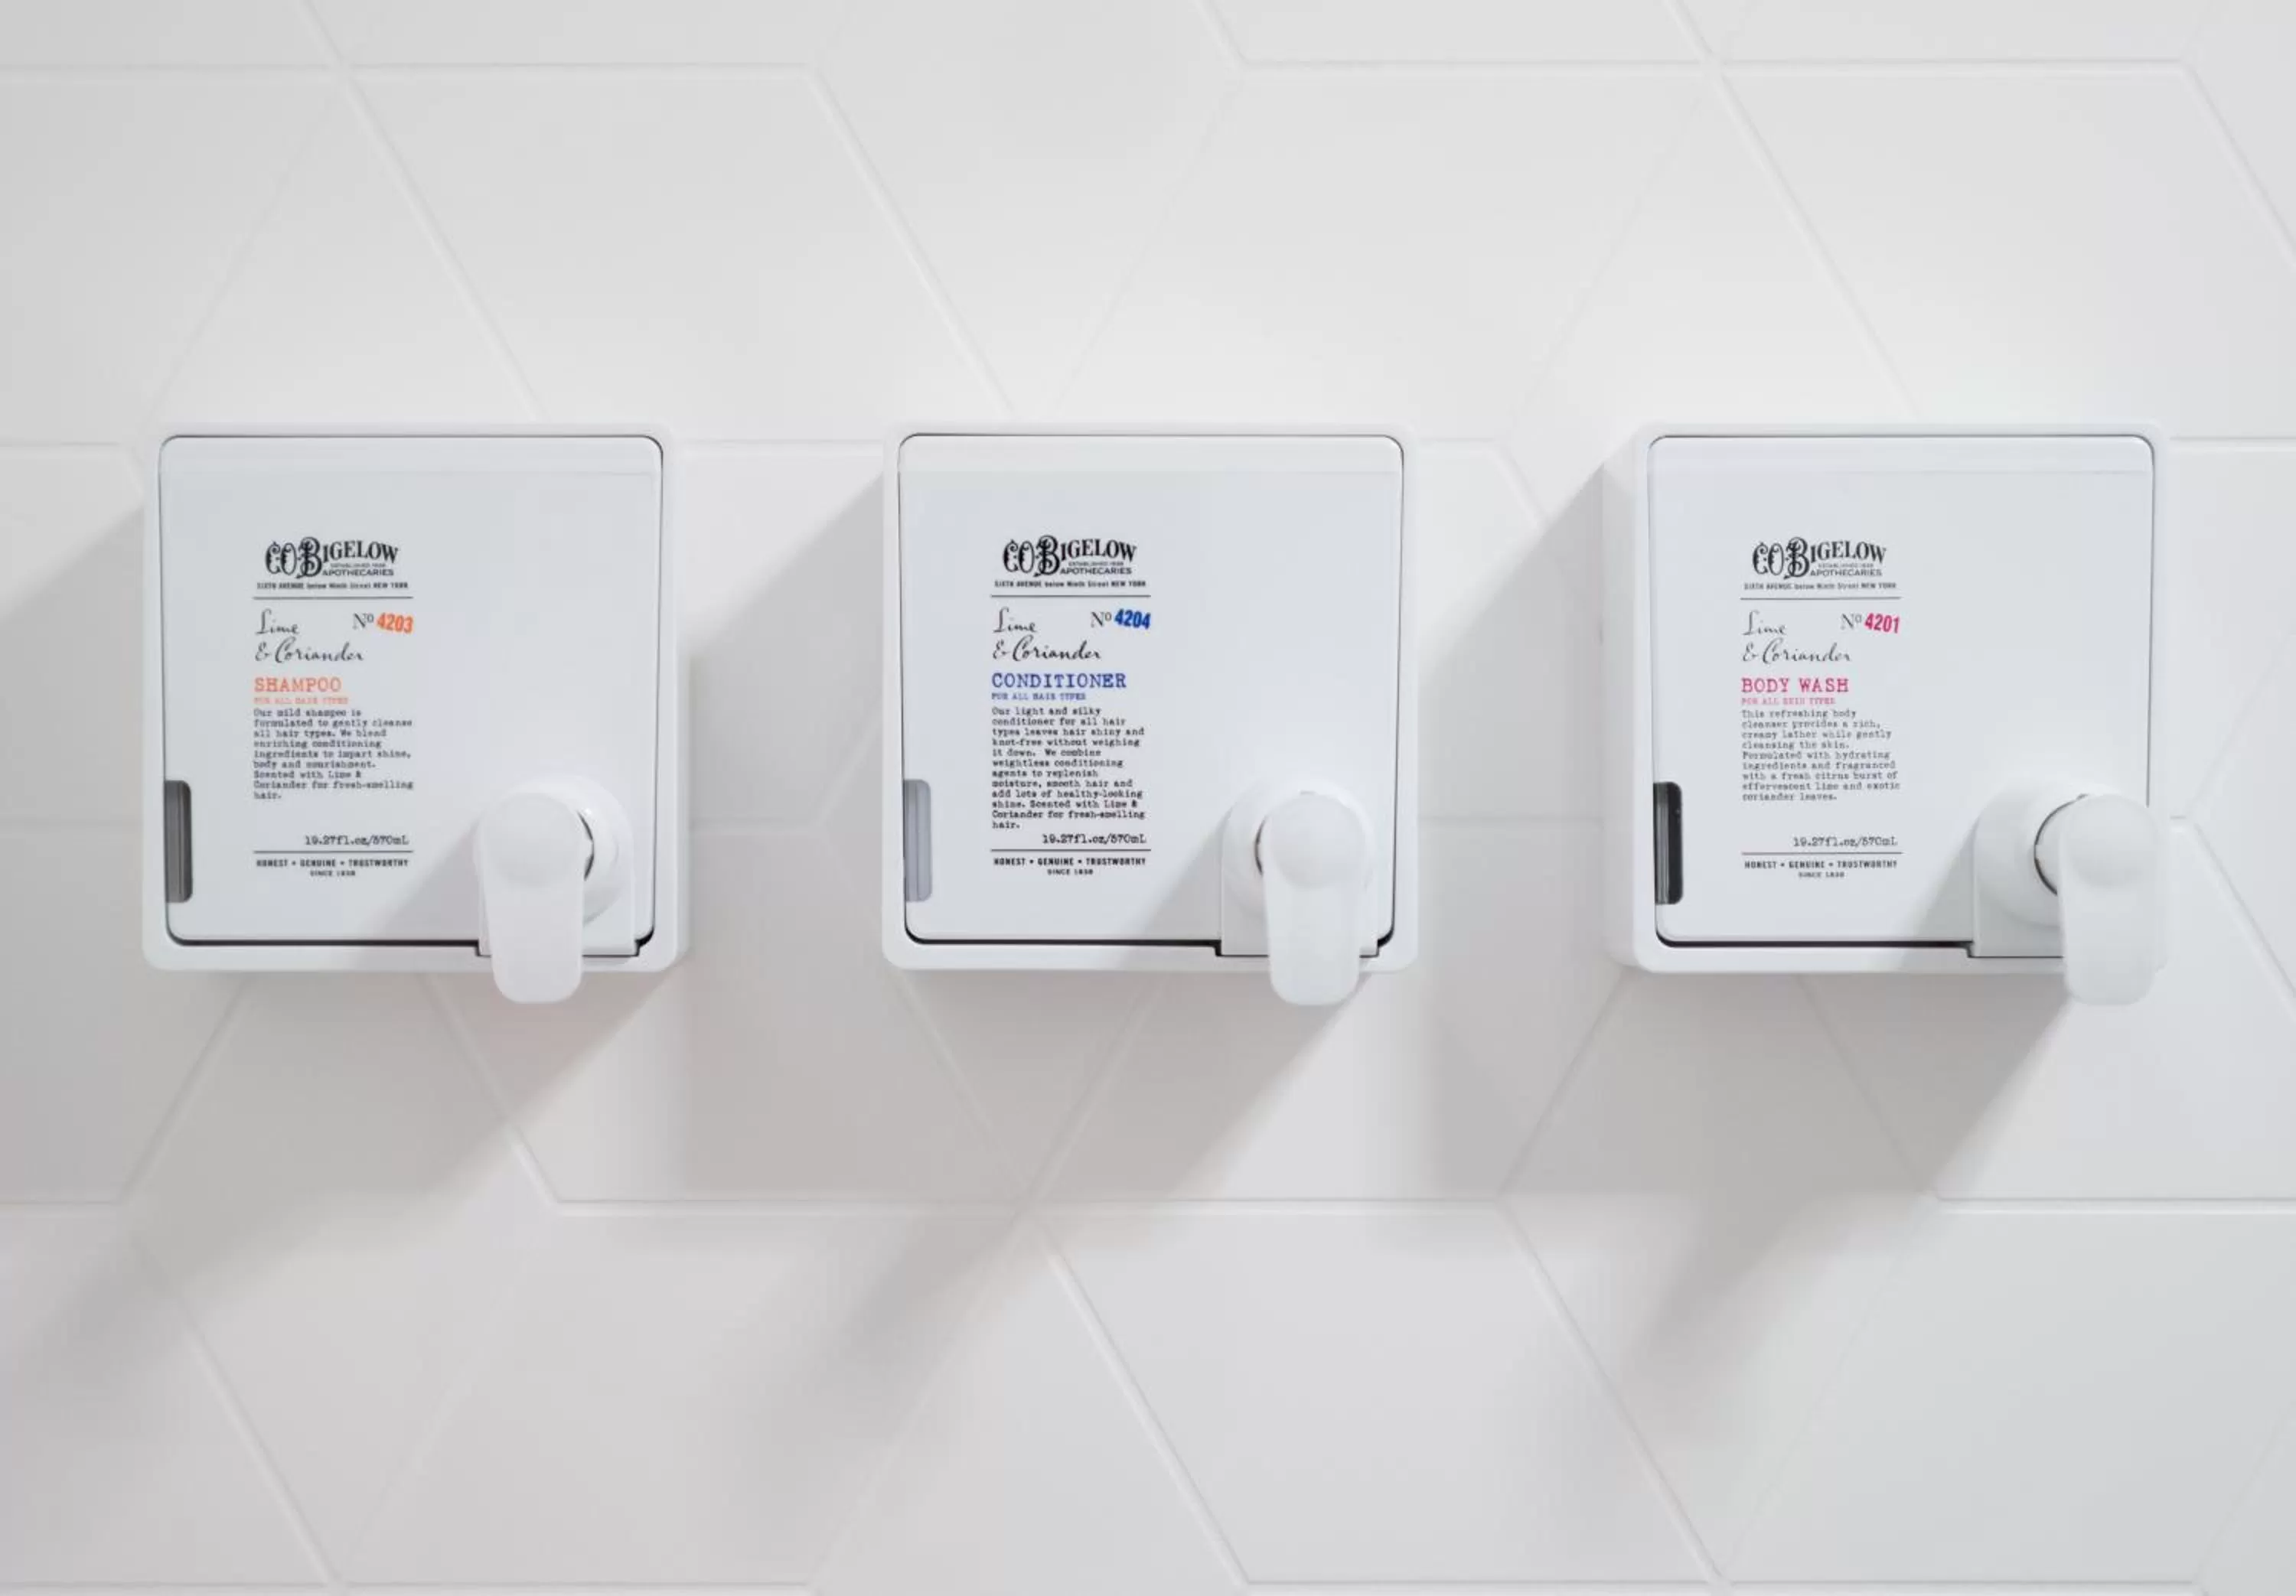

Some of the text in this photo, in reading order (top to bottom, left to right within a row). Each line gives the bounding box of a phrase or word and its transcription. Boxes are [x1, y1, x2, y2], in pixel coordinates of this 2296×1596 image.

[256, 607, 300, 634] Lime
[376, 612, 414, 634] 4203
[993, 607, 1038, 633] Lime
[1114, 608, 1151, 630] 4204
[1742, 610, 1787, 636] Lime
[1864, 612, 1900, 634] 4201
[255, 637, 365, 663] & Coriander
[993, 635, 1101, 661] & Coriander
[1743, 637, 1851, 664] & Coriander
[254, 676, 341, 692] SHAMPOO
[992, 673, 1127, 688] CONDITIONER
[1741, 678, 1849, 693] BODY WASH
[253, 708, 272, 717] Our
[276, 708, 301, 717] mild
[992, 707, 1101, 717] Our light and silky
[1741, 709, 1857, 719] This refreshing body
[254, 718, 313, 728] formulated
[318, 719, 329, 728] to
[331, 719, 367, 728] gently
[992, 717, 1055, 726] conditioner
[1059, 717, 1076, 726] for
[1080, 717, 1097, 725] all
[1742, 720, 1789, 728] cleanser
[1792, 719, 1839, 729] provides
[254, 729, 270, 738] all
[276, 729, 300, 738] hair
[355, 729, 386, 738] blend
[993, 728, 1020, 738] types
[1025, 728, 1058, 736] leaves
[1091, 728, 1121, 737] shiny
[1125, 727, 1144, 735] and
[1782, 730, 1818, 738] lather
[1821, 730, 1852, 738] while
[1856, 730, 1892, 740] gently
[253, 739, 383, 749] enriching conditioning
[1091, 738, 1140, 747] weighing
[1742, 741, 1795, 750] cleansing
[1799, 741, 1818, 749] the
[254, 750, 318, 760] ingredients
[338, 750, 372, 759] impart
[993, 748, 1003, 757] it
[1061, 748, 1101, 757] combine
[1742, 751, 1802, 760] Formulated
[1835, 751, 1890, 761] hydrating
[992, 758, 1124, 768] weightless conditioning
[1743, 761, 1896, 770] ingredients and fragranced
[254, 770, 295, 779] Scented
[328, 770, 352, 780] Lime
[992, 770, 1028, 778] agents
[1045, 769, 1098, 779] replenish
[1742, 772, 1766, 780] with
[1781, 771, 1812, 780] fresh
[1815, 771, 1849, 780] citrus
[1853, 771, 1883, 780] burst
[1887, 771, 1898, 780] of
[253, 780, 413, 790] Coriander for fresh-smelling
[1114, 779, 1133, 787] and
[1742, 782, 1812, 791] effervescent
[1815, 782, 1839, 790] lime
[1843, 782, 1862, 790] and
[992, 789, 1143, 799] add lots of healthy-looking
[1029, 800, 1071, 809] Scented
[1104, 800, 1127, 808] Lime
[992, 809, 1146, 819] Coriander for fresh-smelling
[1789, 861, 1825, 869] GENUINE
[1837, 860, 1897, 868] TRUSTWORTHY
